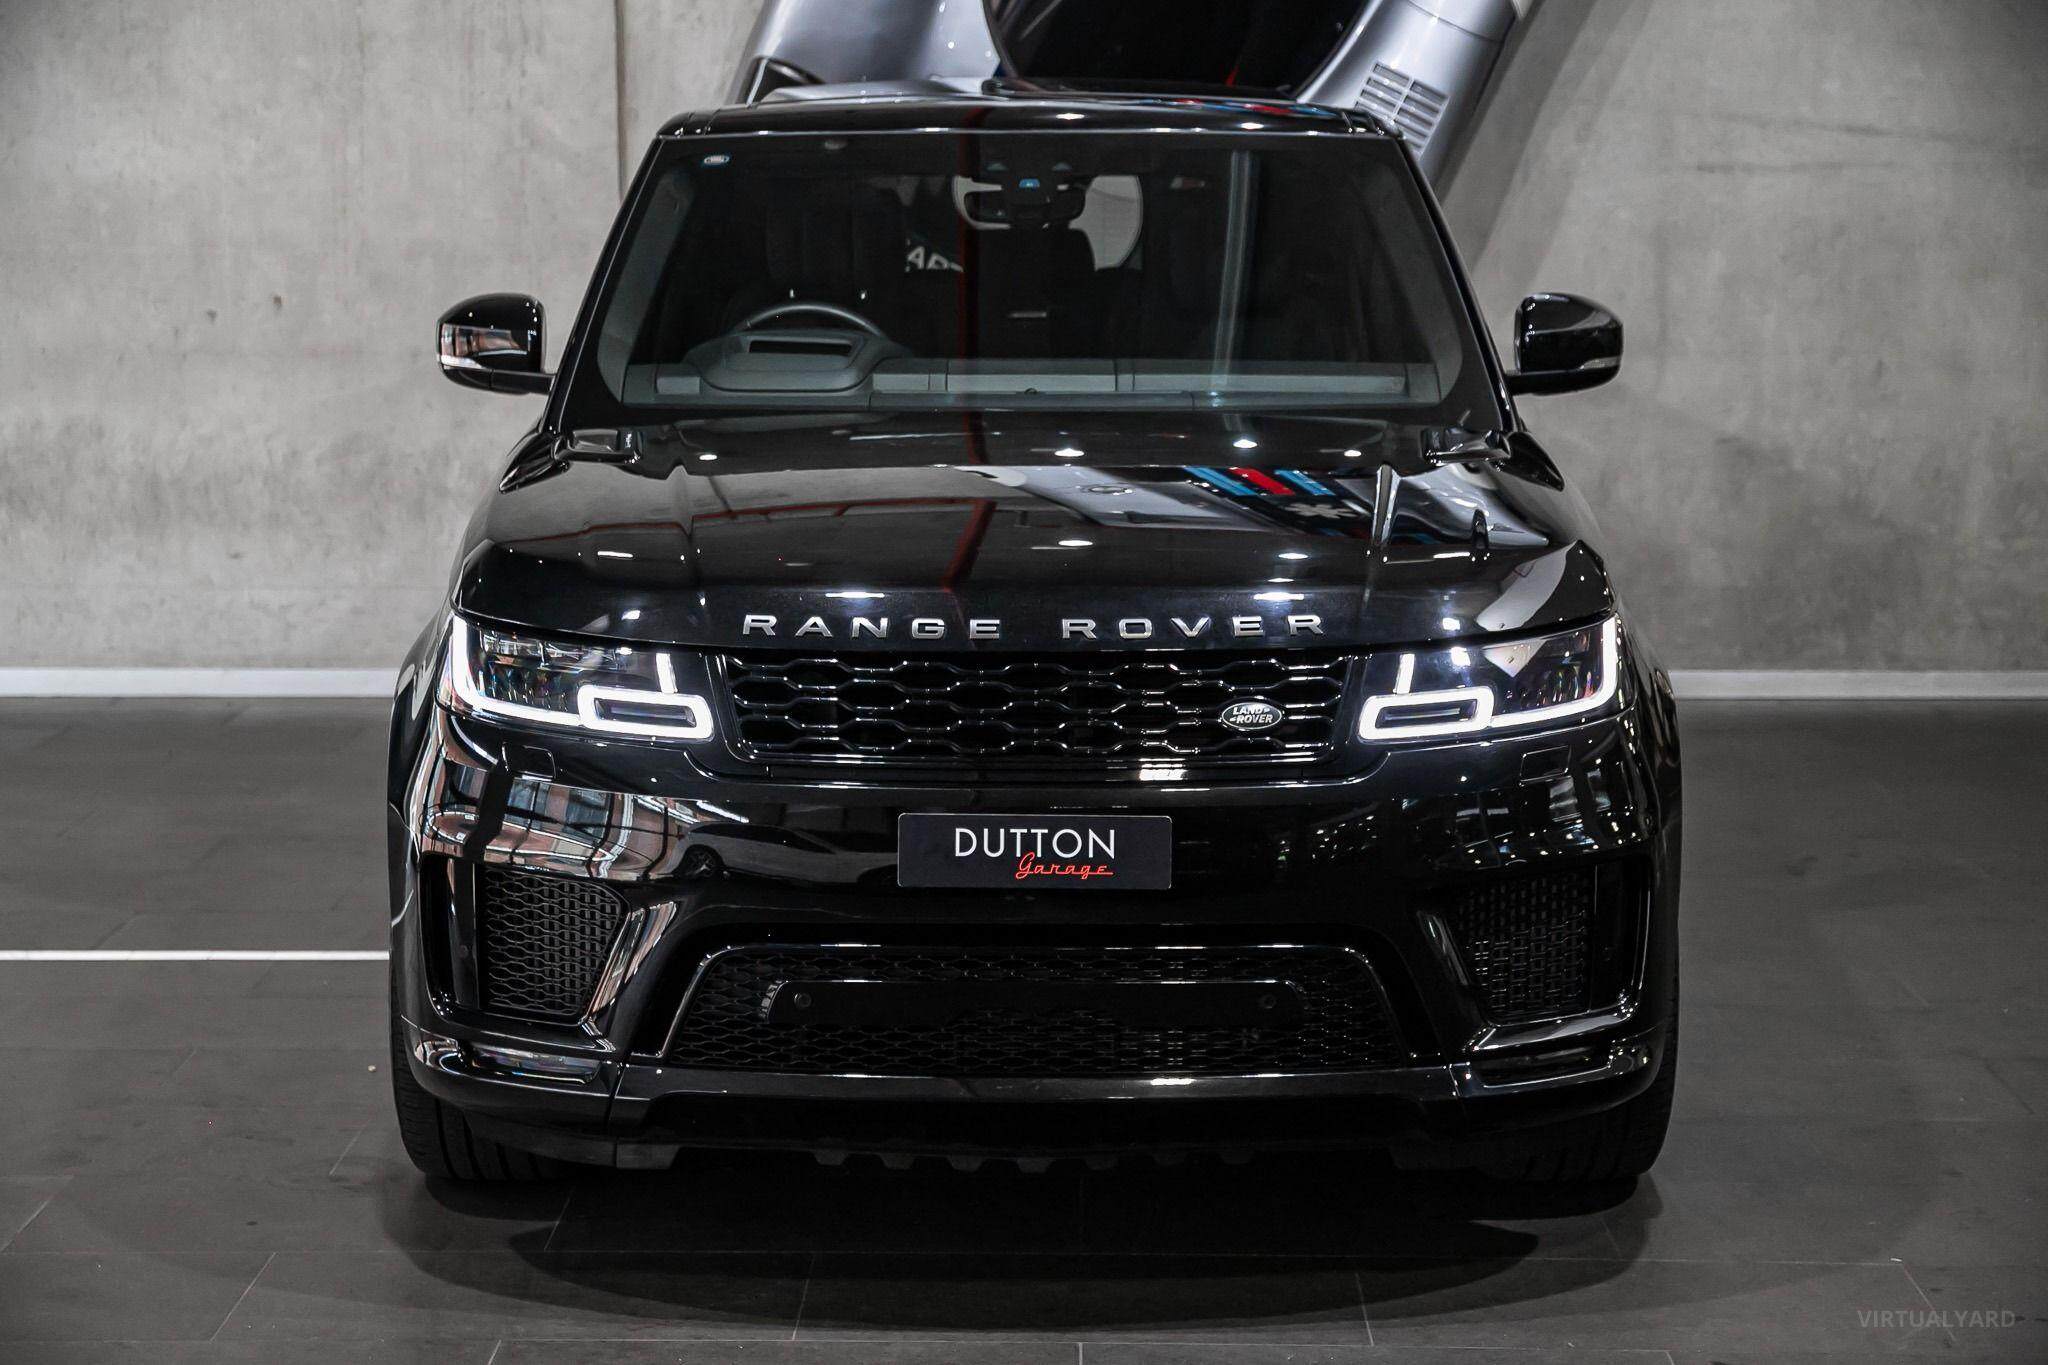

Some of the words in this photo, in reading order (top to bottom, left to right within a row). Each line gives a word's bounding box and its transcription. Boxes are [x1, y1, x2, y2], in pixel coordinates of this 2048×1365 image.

[742, 614, 1001, 639] RANGE
[1061, 614, 1323, 639] ROVER
[1232, 703, 1265, 715] LAND
[1236, 714, 1273, 724] ROVER
[955, 828, 1115, 859] DUTTON
[1015, 851, 1114, 880] Garage
